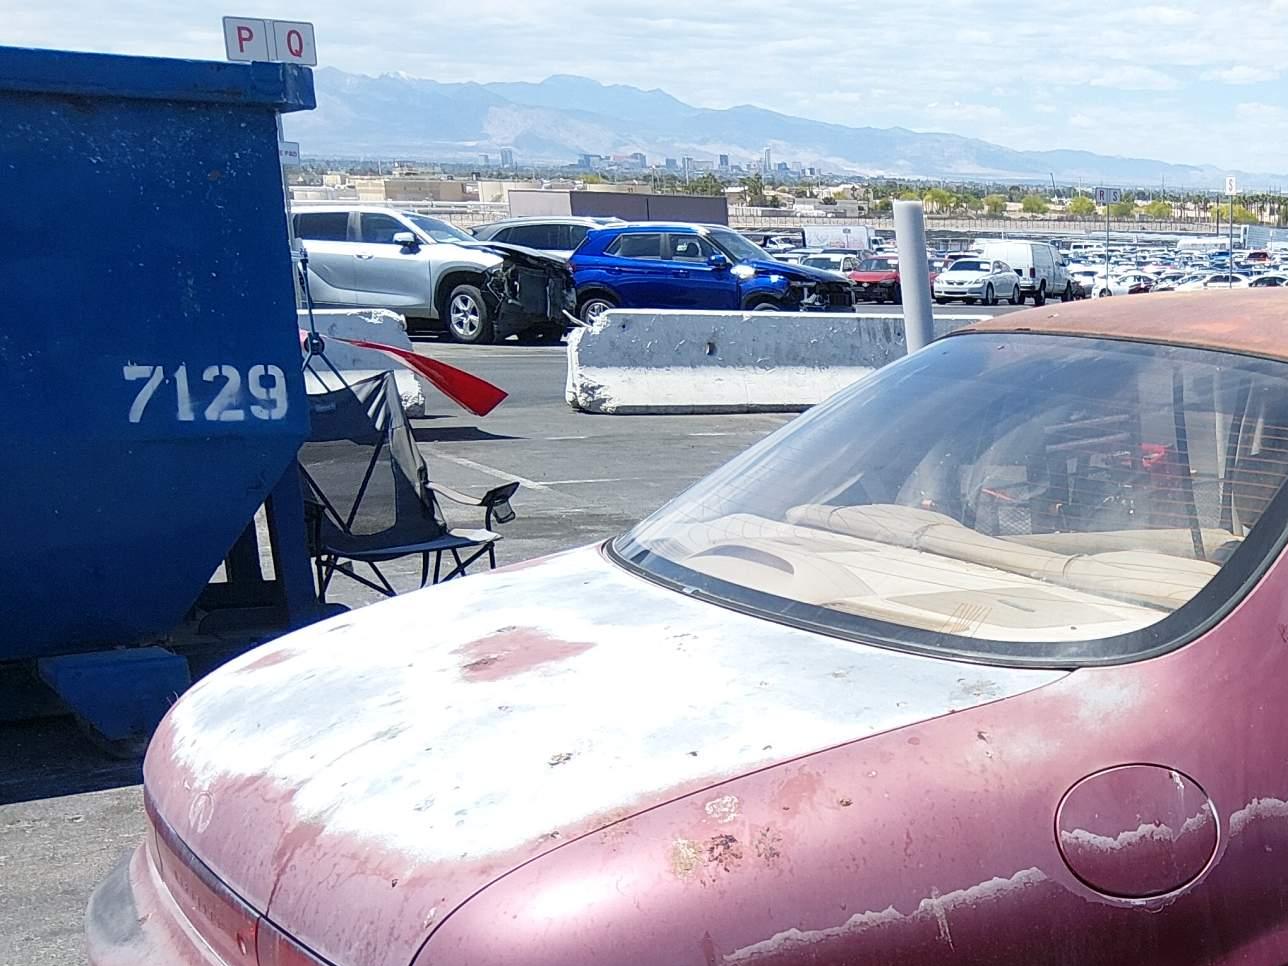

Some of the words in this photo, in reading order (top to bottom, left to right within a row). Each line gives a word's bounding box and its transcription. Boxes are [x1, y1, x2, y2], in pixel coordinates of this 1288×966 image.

[236, 26, 254, 53] P
[286, 29, 304, 58] Q
[123, 364, 289, 423] 7129
